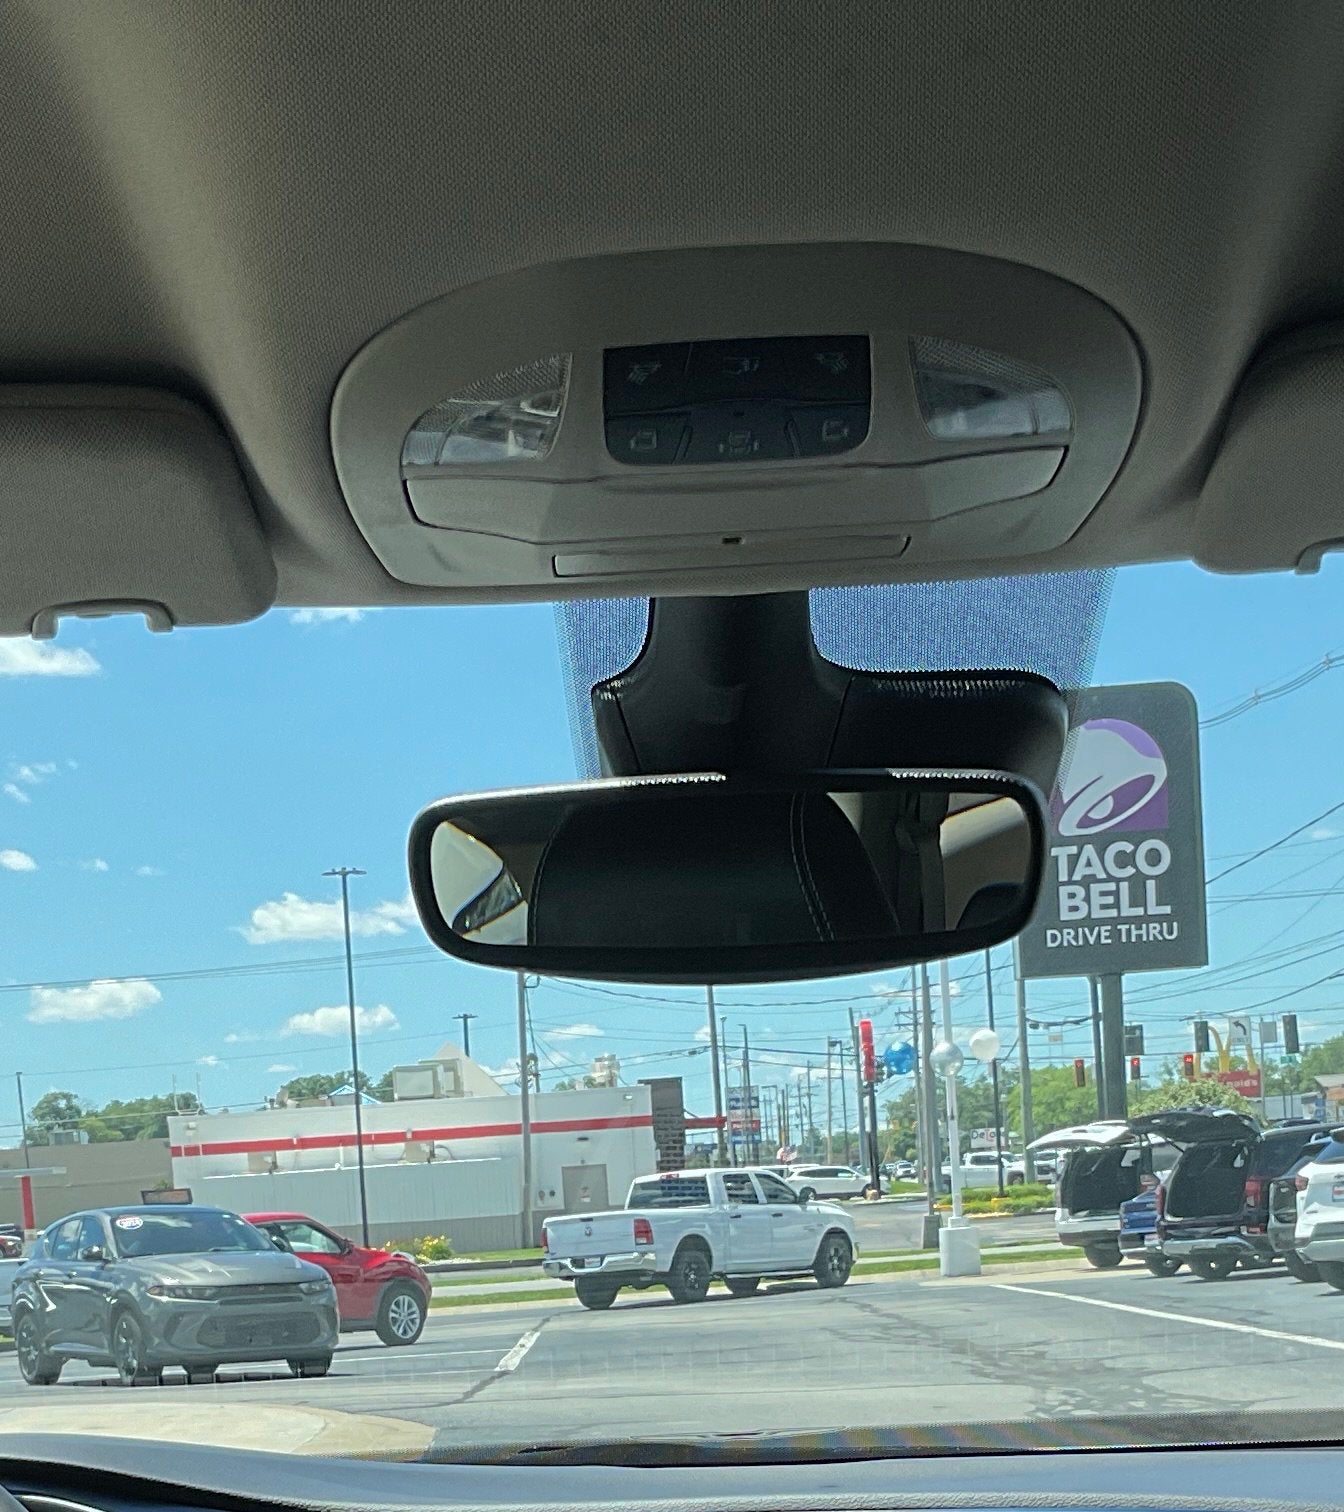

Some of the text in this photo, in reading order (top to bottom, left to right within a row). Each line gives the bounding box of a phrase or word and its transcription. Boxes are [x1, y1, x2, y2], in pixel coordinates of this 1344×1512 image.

[1051, 839, 1171, 882] TACO
[1058, 879, 1172, 921] BELL
[1046, 921, 1179, 948] DRIVE THRU
